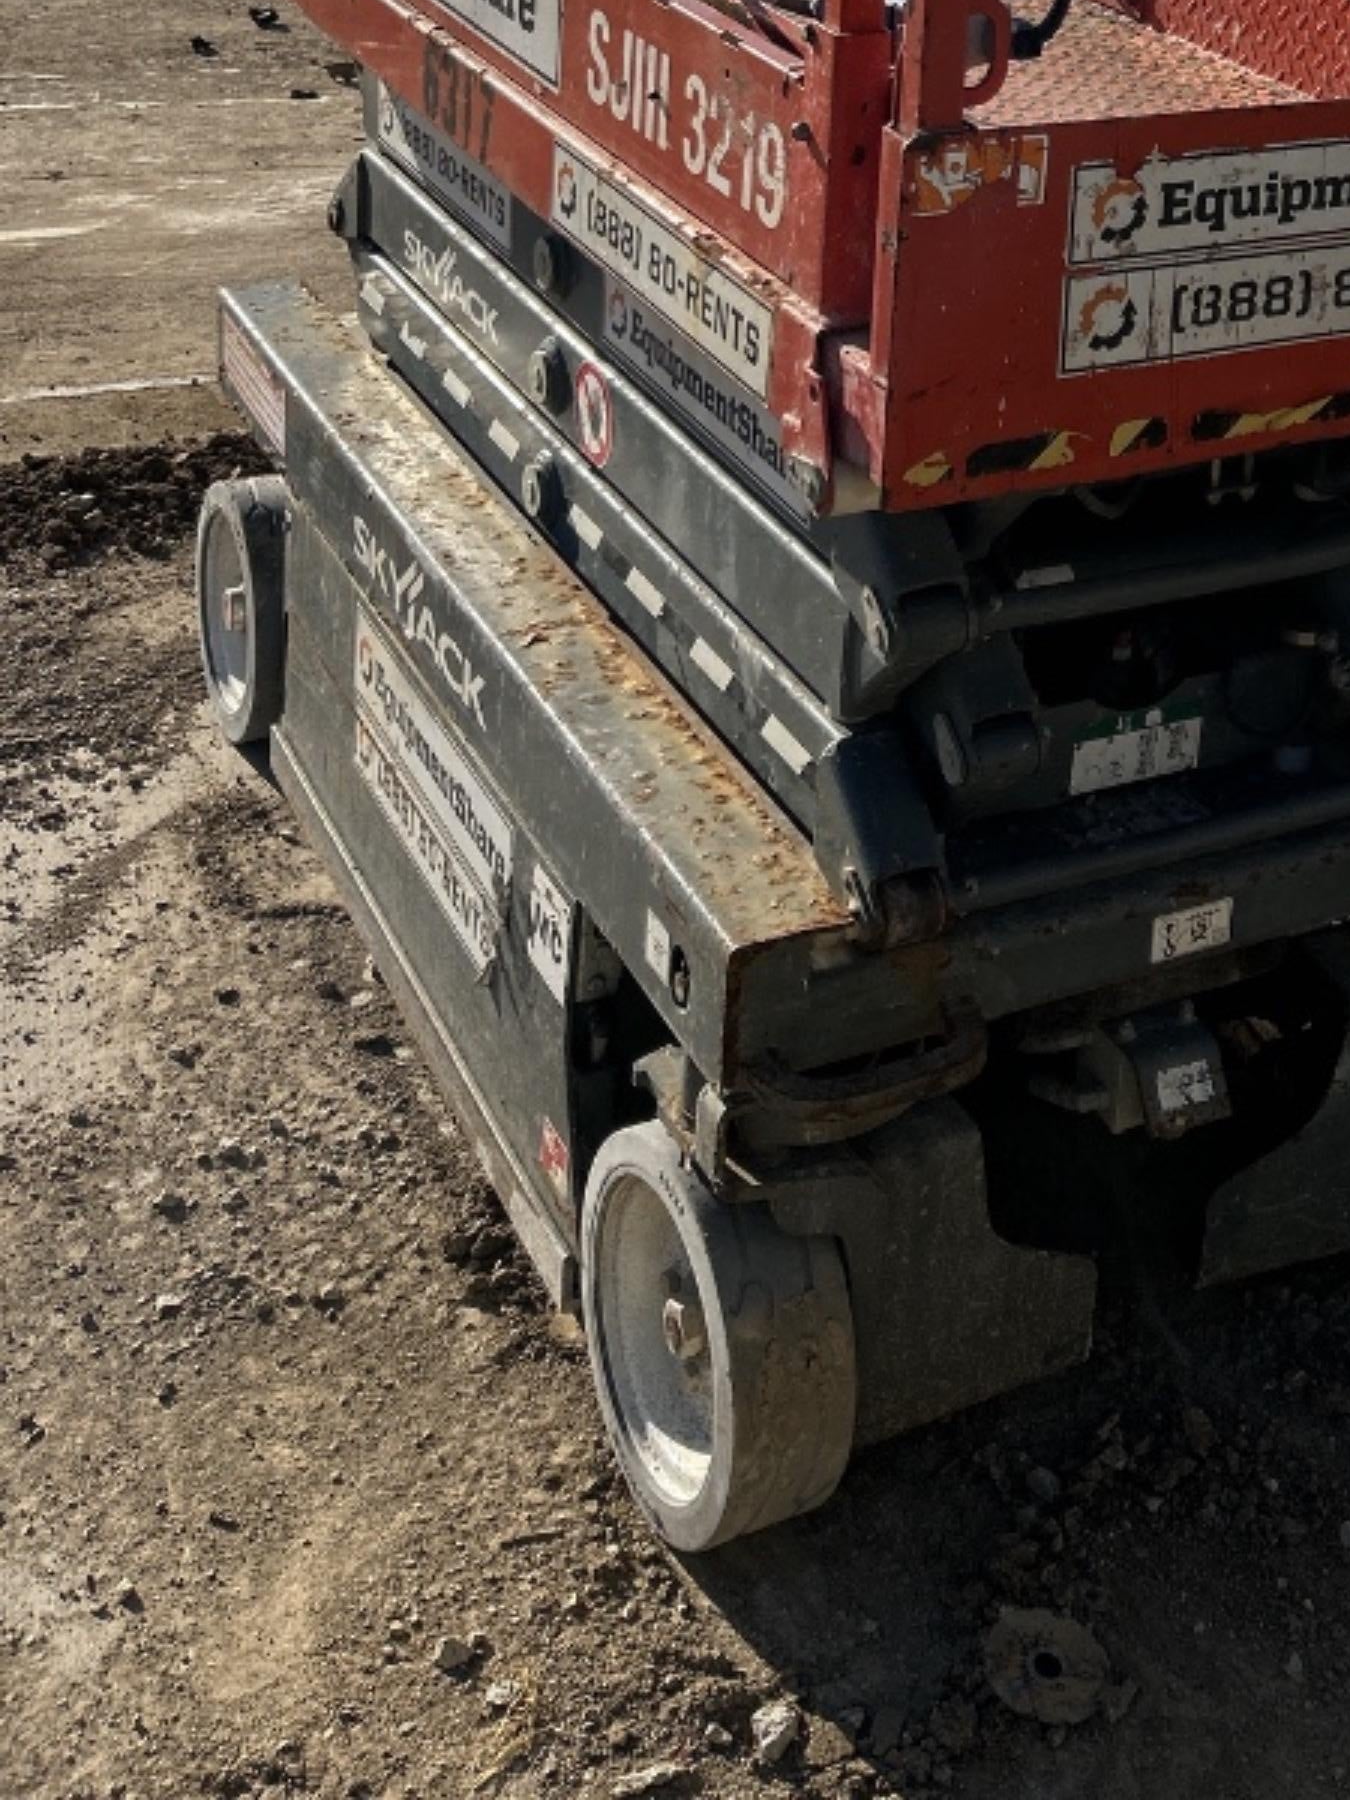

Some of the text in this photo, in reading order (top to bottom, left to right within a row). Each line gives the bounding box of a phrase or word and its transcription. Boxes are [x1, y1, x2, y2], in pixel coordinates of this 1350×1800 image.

[682, 73, 786, 229] 3219
[586, 188, 761, 367] (888) 80-RENTS
[1170, 266, 1312, 334] (888)
[353, 515, 487, 732] SKYJACK
